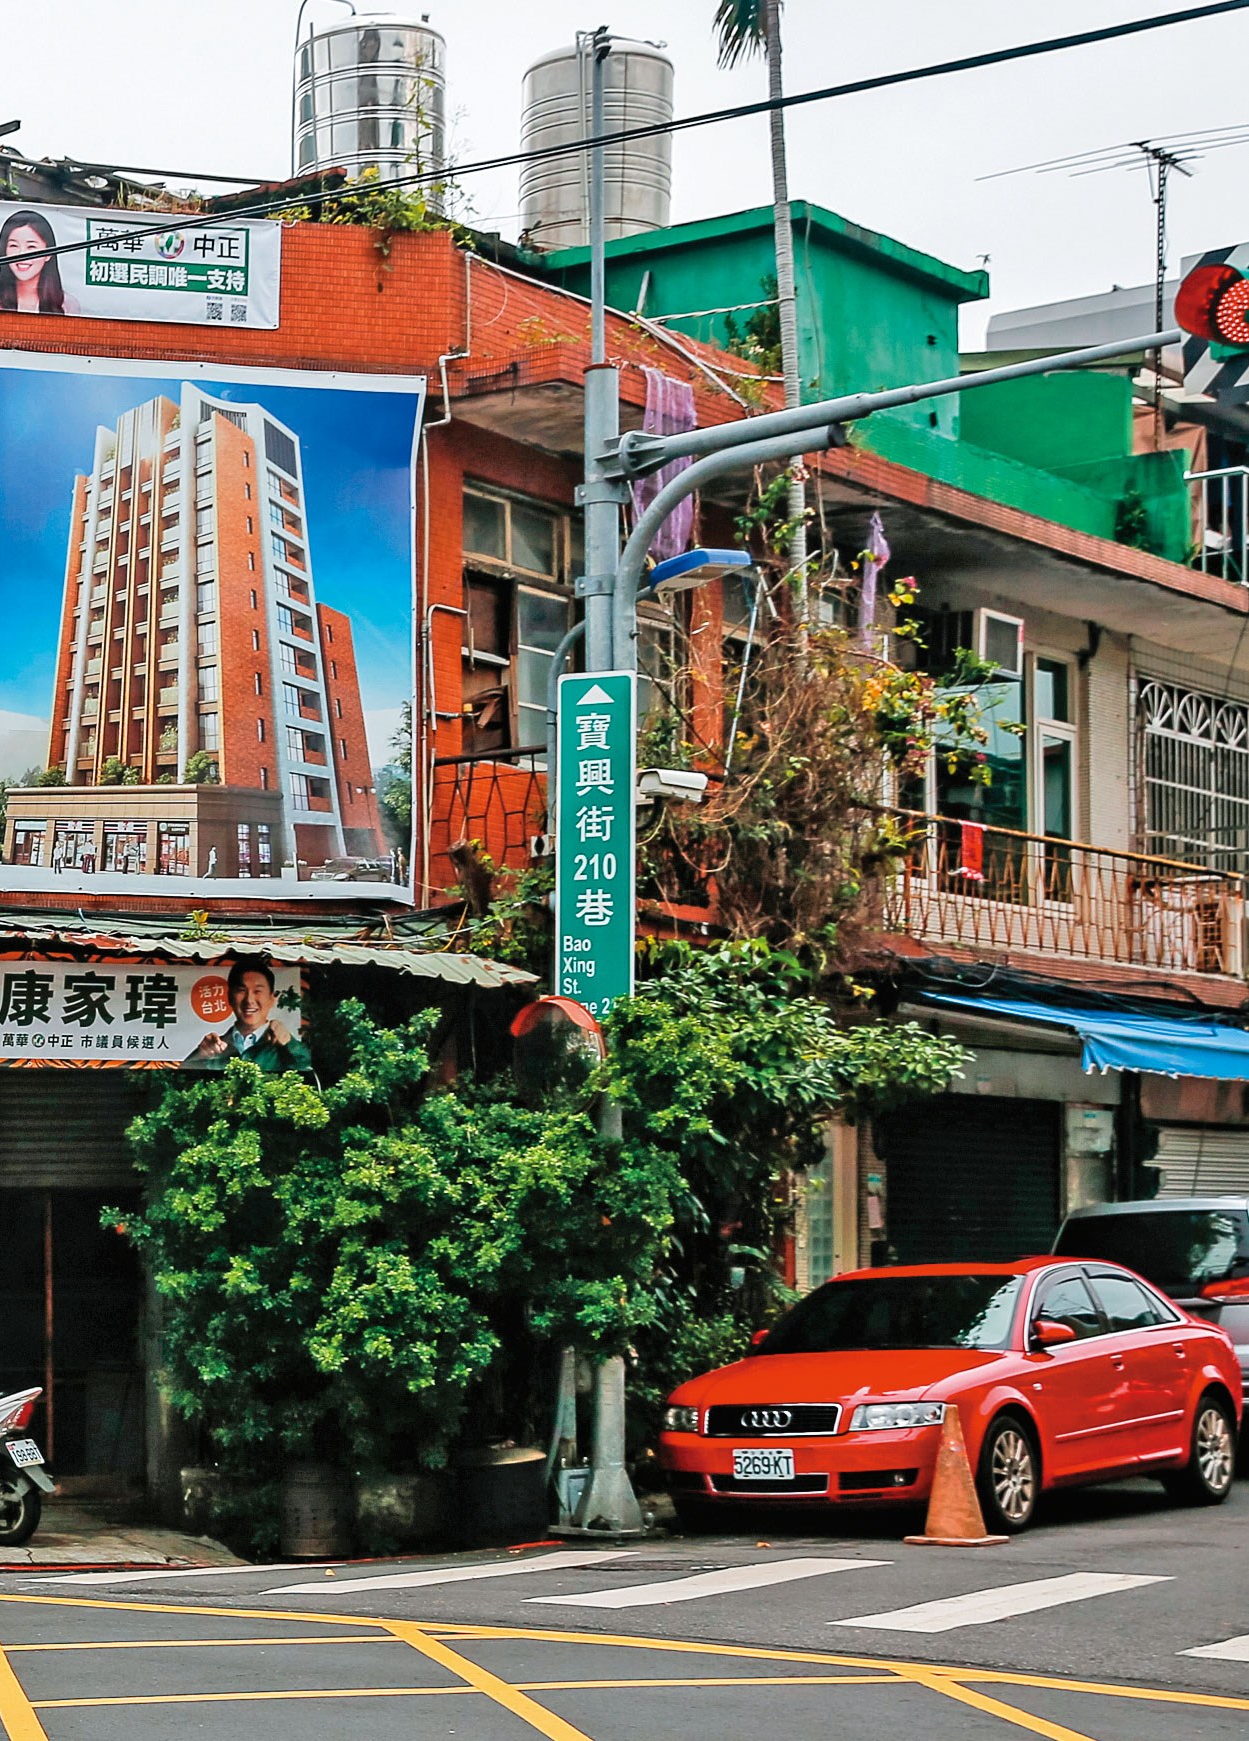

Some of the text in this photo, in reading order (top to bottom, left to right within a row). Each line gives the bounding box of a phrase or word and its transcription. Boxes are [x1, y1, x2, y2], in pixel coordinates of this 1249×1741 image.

[193, 234, 241, 260] 中正
[89, 261, 246, 292] 初選民調唯一支持
[573, 713, 617, 926] 寶興街210巷
[563, 936, 592, 952] Bao
[563, 957, 596, 977] Xing
[199, 986, 225, 999] 活力
[563, 978, 582, 994] St.
[201, 999, 227, 1013] 台北
[2, 1033, 170, 1050] 萬華 中正 市議員候選人
[734, 1456, 793, 1475] 5269-KT
